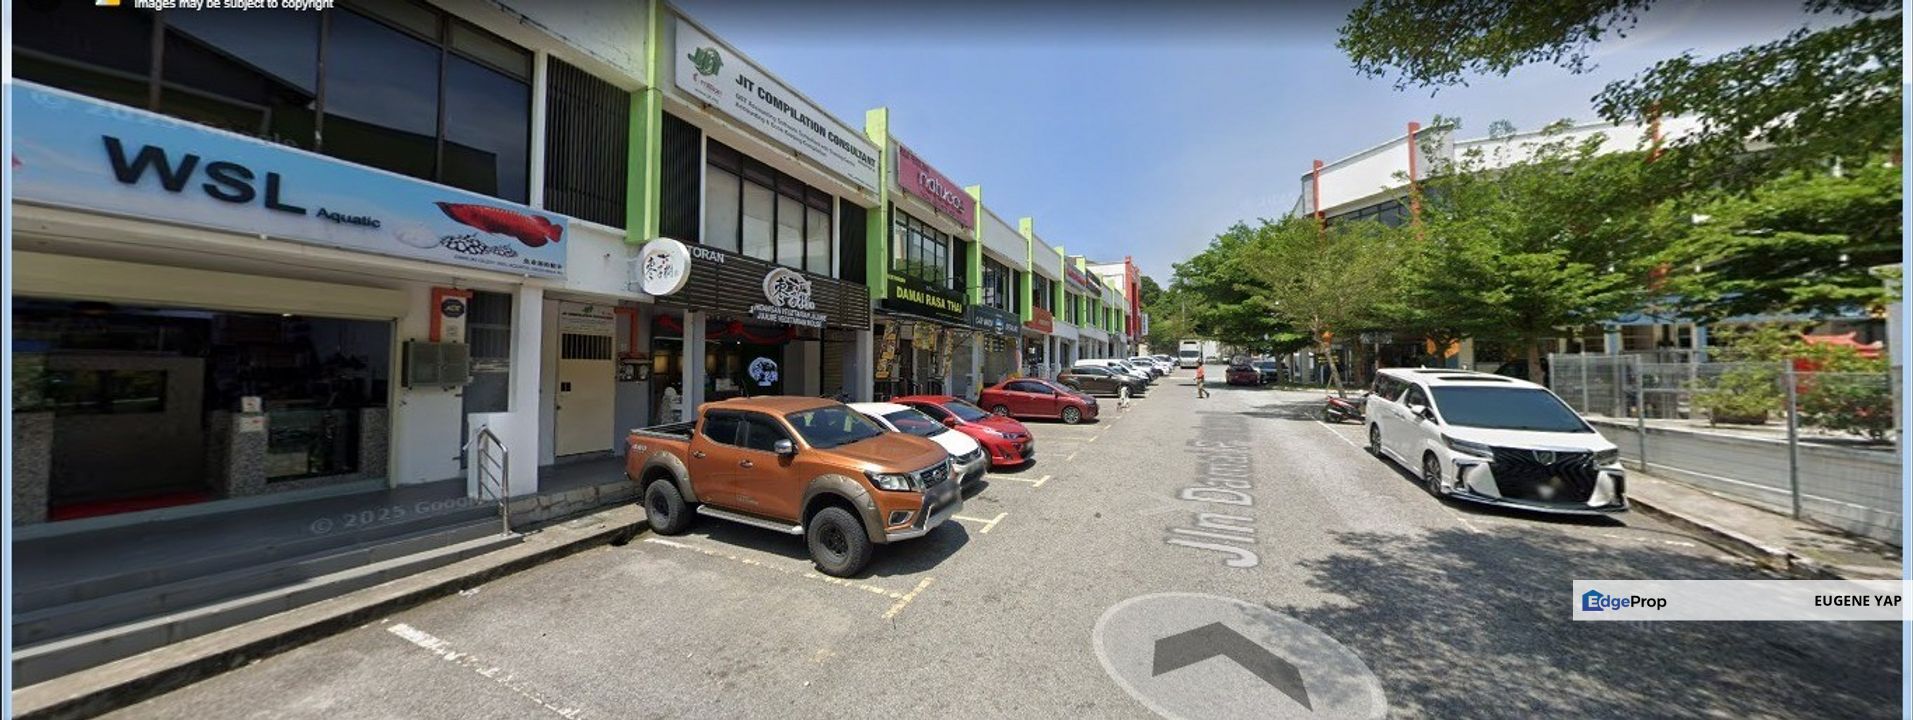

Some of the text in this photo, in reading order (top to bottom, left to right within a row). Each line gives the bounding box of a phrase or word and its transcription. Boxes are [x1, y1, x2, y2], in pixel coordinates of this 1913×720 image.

[735, 74, 755, 92] JIT
[757, 86, 826, 137] COMPILATION
[827, 131, 876, 167] CONSULTANT
[102, 135, 381, 230] WSL Aquatic
[896, 286, 924, 304] DAMAI
[925, 294, 946, 309] RASA
[946, 300, 963, 314] THAI
